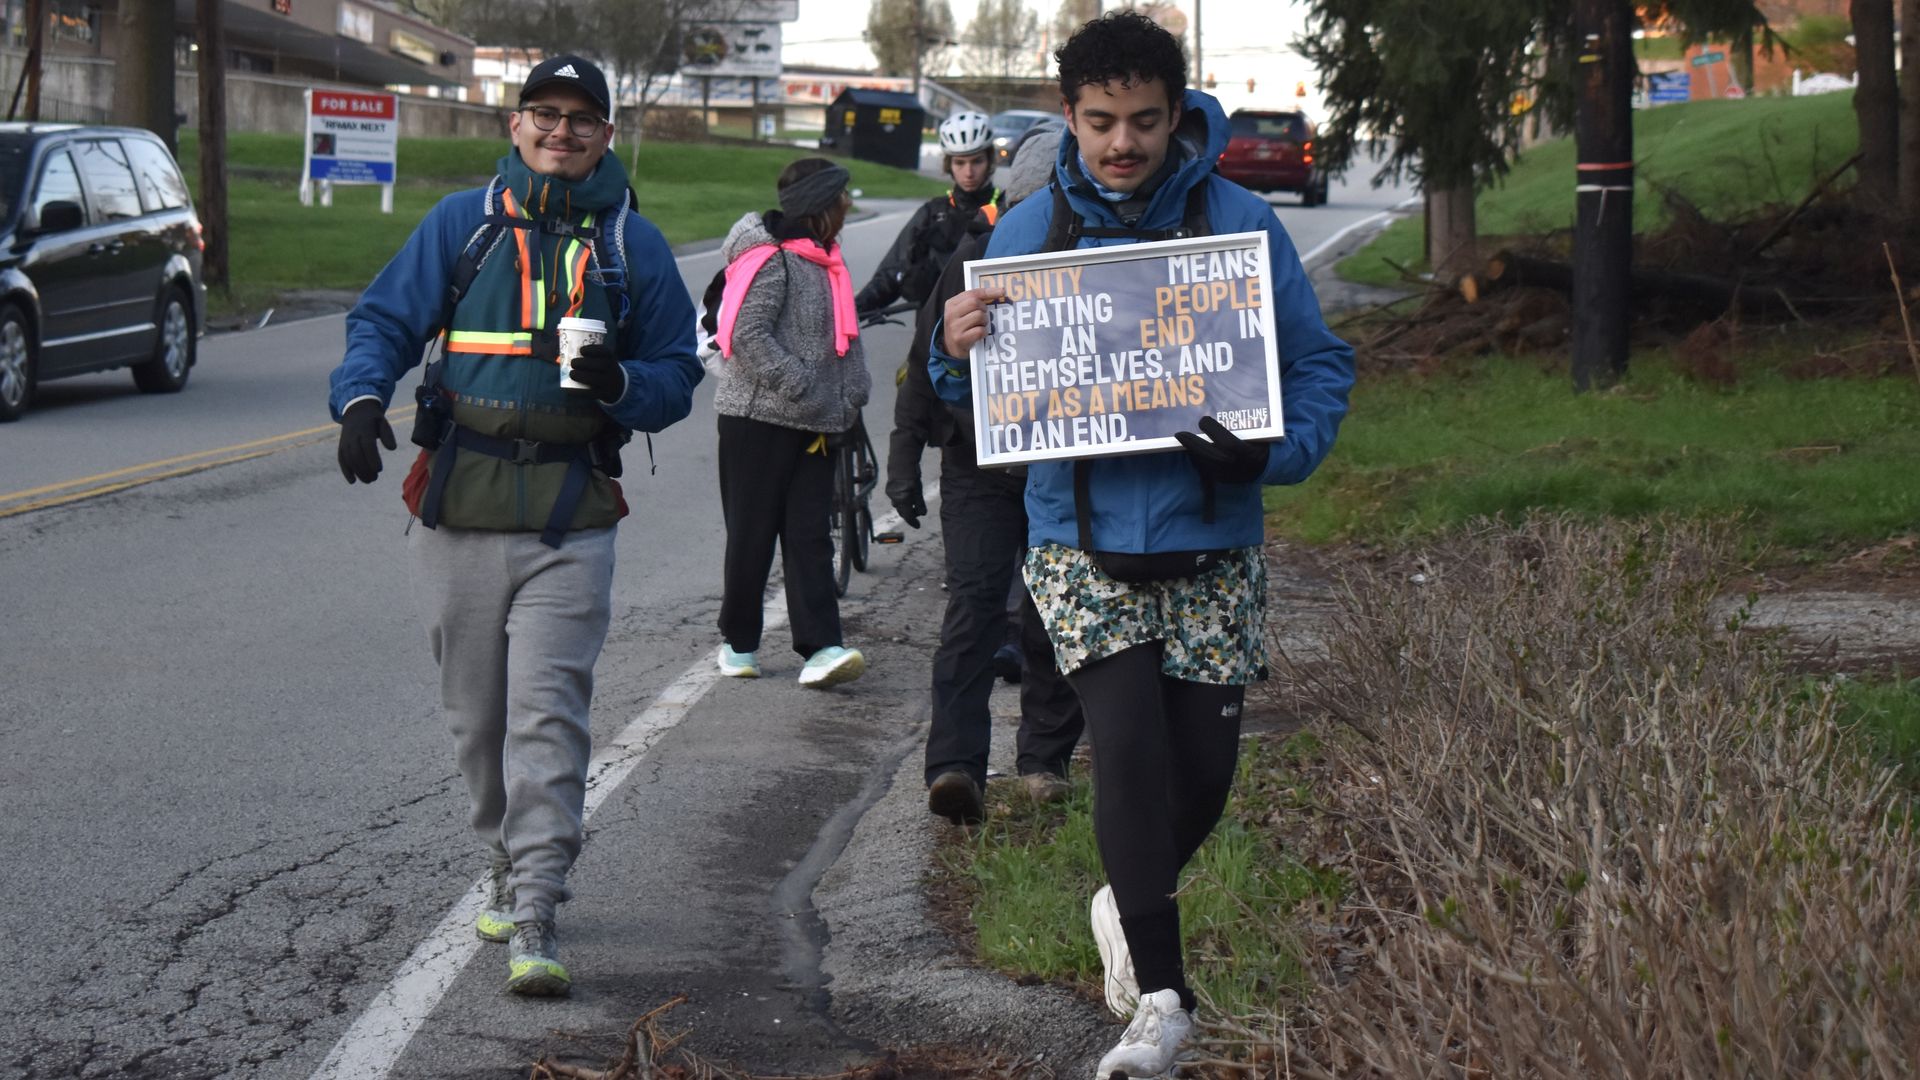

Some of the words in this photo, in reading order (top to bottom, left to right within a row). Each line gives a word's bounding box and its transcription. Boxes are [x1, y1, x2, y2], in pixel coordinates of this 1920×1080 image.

[321, 97, 347, 111] FOR
[351, 99, 384, 113] SALE
[360, 122, 386, 133] NEXT
[1168, 249, 1259, 285] MEANS
[1156, 278, 1262, 317] PEOPLE
[985, 332, 1018, 365] AS
[1061, 325, 1097, 357] AN
[1140, 314, 1195, 349] END
[1239, 307, 1265, 339] IN
[986, 348, 1172, 394] THEMSELVES,
[1179, 341, 1234, 376] AND
[988, 391, 1040, 425] NOT
[1047, 387, 1082, 418] AS
[1089, 384, 1106, 415] A
[1112, 374, 1206, 412] MEANS
[1217, 407, 1268, 421] FRONTLINE
[990, 423, 1023, 455] TO
[1030, 419, 1066, 450] AN
[1072, 413, 1137, 447] END.
